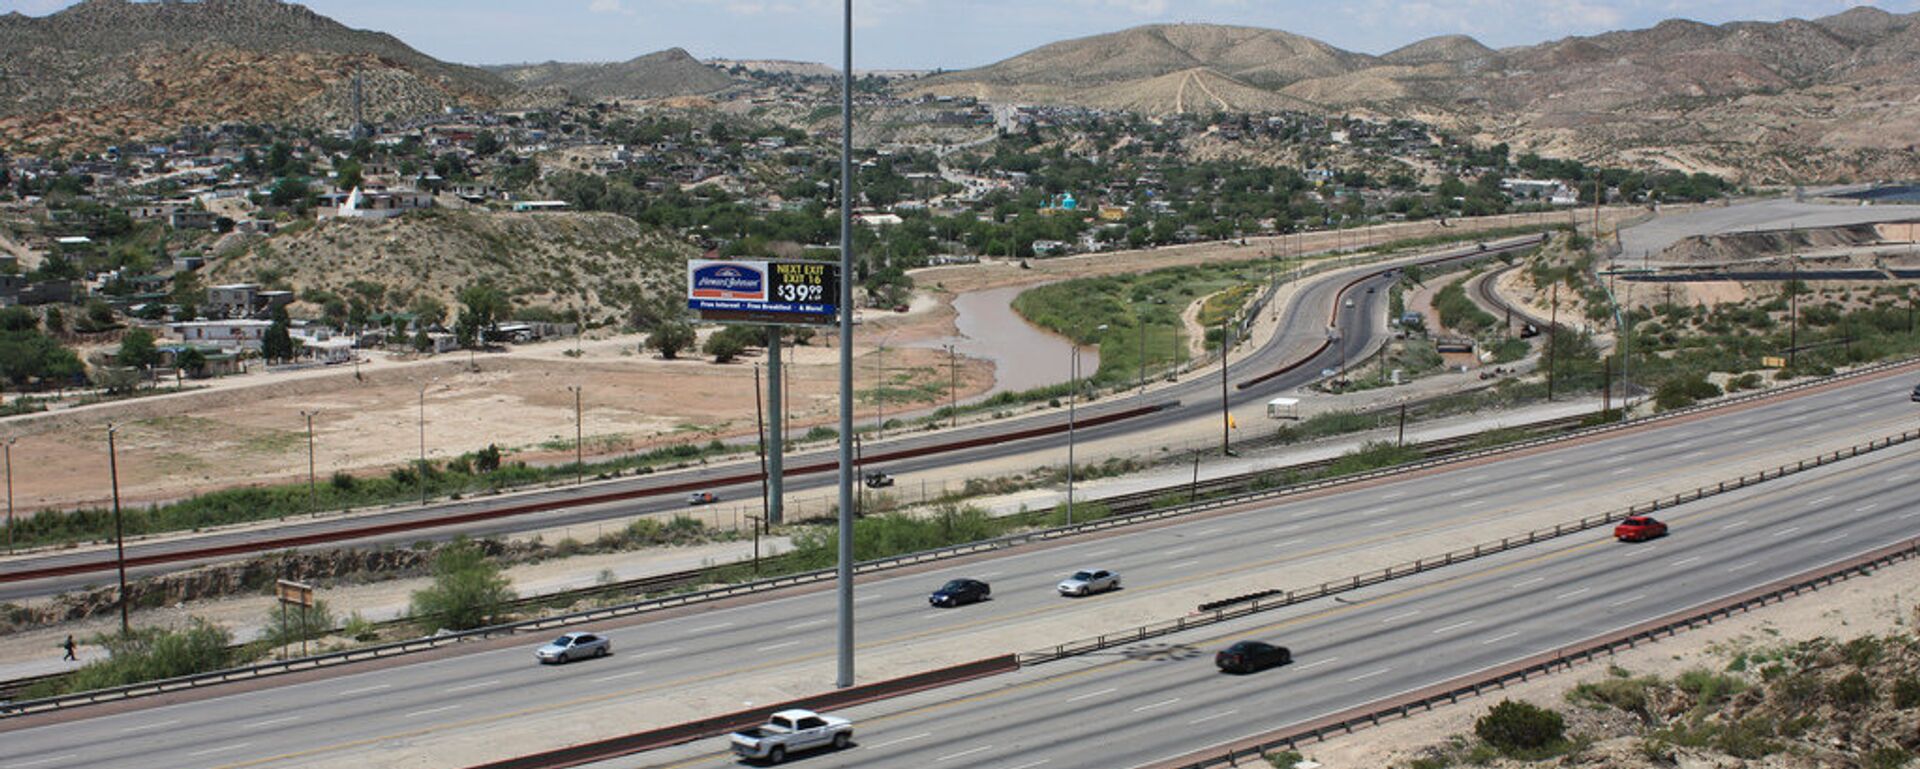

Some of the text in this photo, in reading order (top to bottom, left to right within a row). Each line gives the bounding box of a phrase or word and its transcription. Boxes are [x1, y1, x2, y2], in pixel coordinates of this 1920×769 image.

[777, 264, 824, 275] NEXT EXIT
[698, 276, 758, 288] Howard Johnson
[783, 273, 821, 284] EXIT 16
